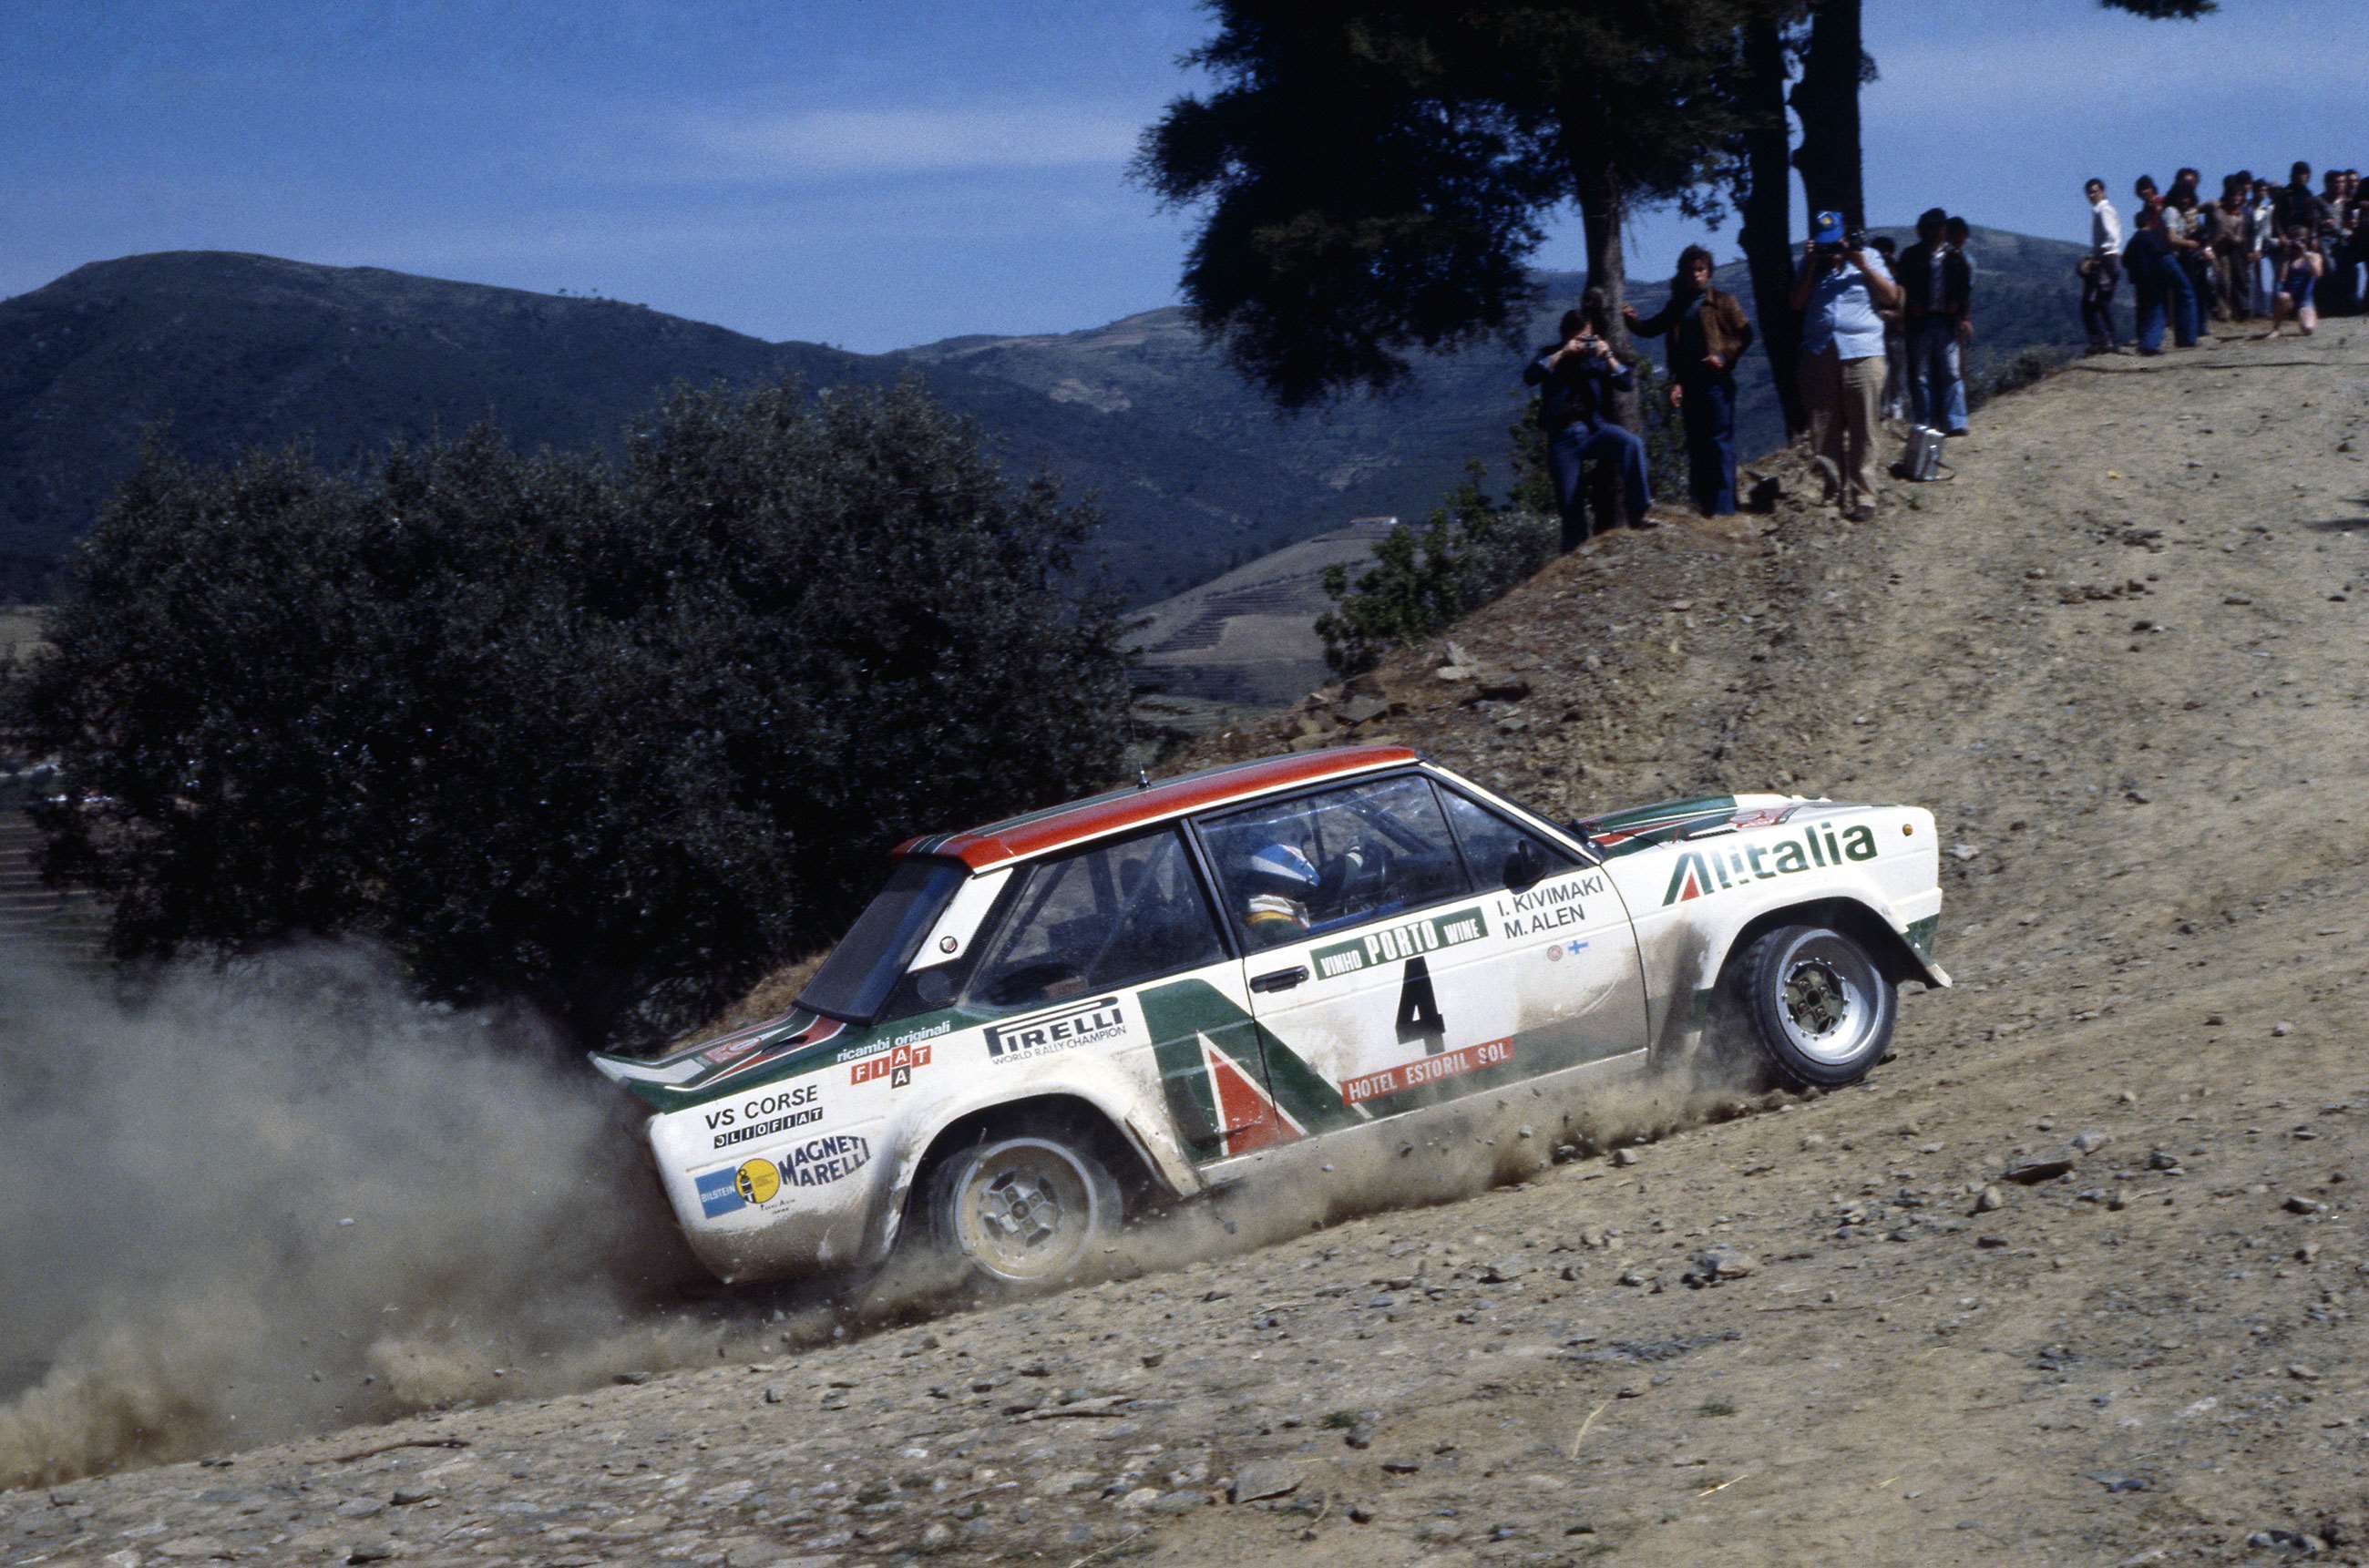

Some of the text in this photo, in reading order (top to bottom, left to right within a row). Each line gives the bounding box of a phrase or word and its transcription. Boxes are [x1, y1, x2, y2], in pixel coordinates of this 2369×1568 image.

[1662, 823, 1879, 907] Alitalia
[1497, 875, 1605, 917] I. KIVIMAKI
[1503, 904, 1586, 939] M. ALEN
[1320, 917, 1481, 977] VINHO PORTO WINE
[982, 997, 1123, 1059] PIRELLI
[1395, 956, 1446, 1056] 4
[837, 1020, 950, 1062] ricambi originali
[993, 1025, 1126, 1065] WORLD RALLY CHAMPION
[850, 1044, 931, 1085] FIAT
[1349, 1043, 1509, 1102] HOTEL ESTORIL SOL
[704, 1084, 818, 1130] VS CORSE
[701, 1185, 736, 1203] BILSTEIN
